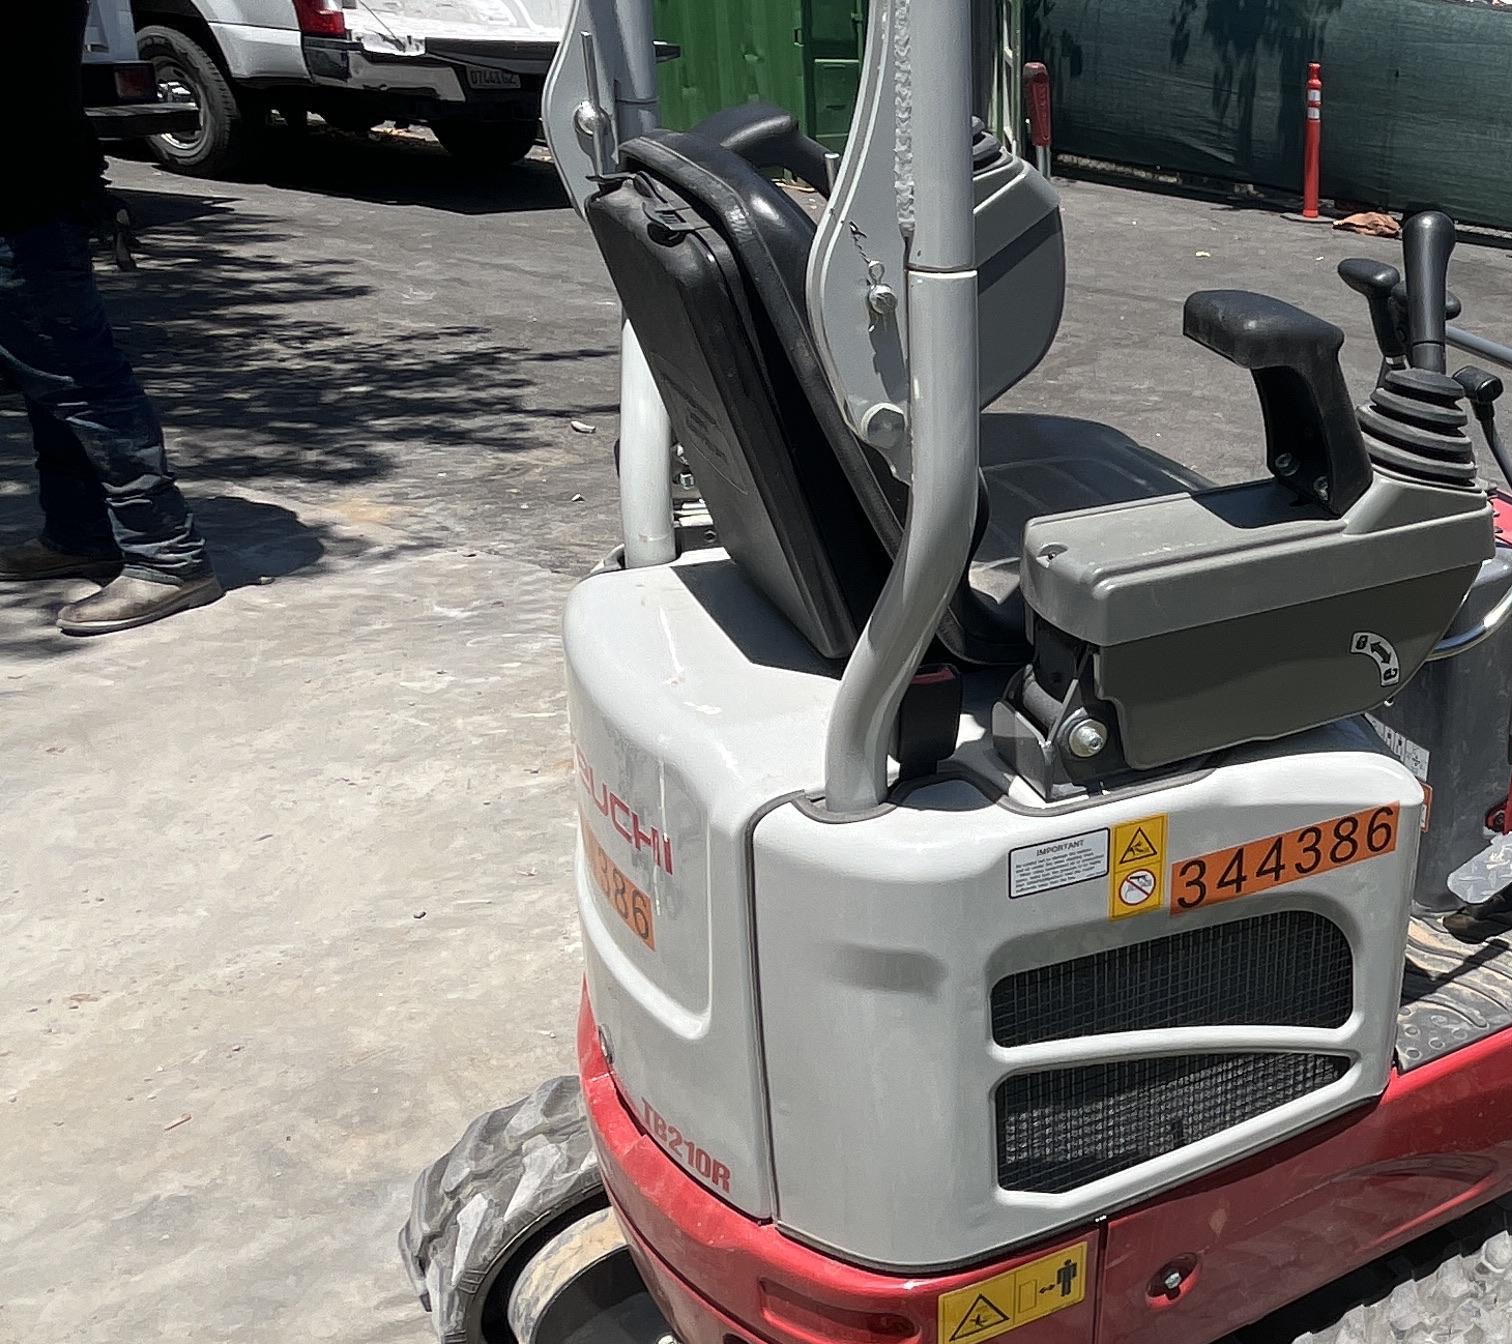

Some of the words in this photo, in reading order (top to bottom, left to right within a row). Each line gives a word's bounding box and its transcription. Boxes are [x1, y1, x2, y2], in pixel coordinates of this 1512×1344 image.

[1036, 840, 1085, 856] IMPORTANT
[1177, 806, 1394, 908] 344386
[640, 1096, 731, 1194] TB210R
